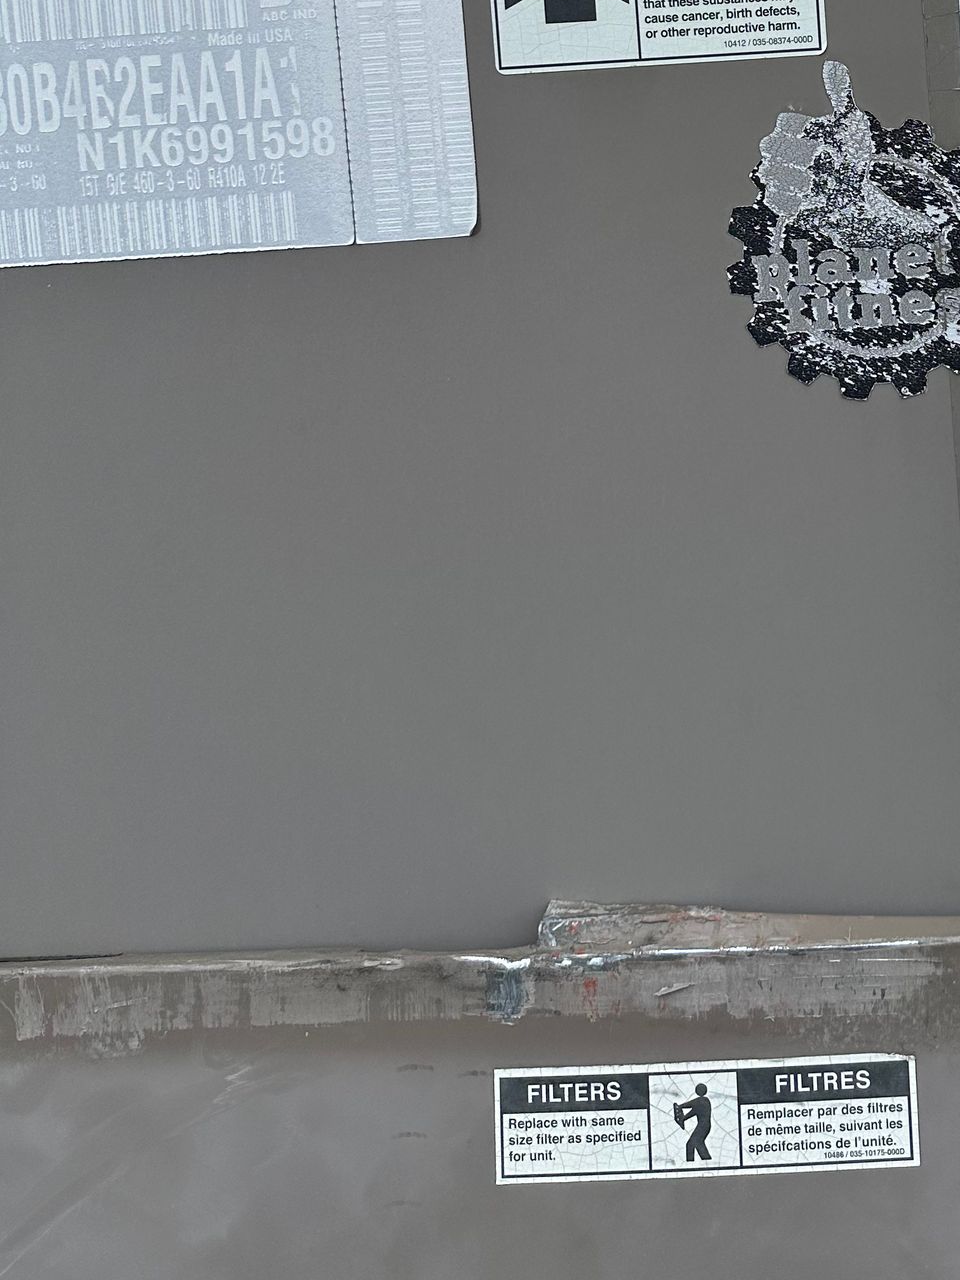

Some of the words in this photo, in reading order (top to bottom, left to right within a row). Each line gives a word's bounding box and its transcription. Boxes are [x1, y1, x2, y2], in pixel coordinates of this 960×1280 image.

[644, 13, 679, 24] cause
[681, 11, 724, 22] cancer,
[725, 7, 753, 19] birth
[754, 5, 800, 18] defects,
[207, 31, 243, 47] Made
[645, 29, 658, 39] or
[660, 26, 691, 38] other
[693, 22, 766, 38] reproductive
[767, 20, 801, 32] harm.
[77, 117, 336, 172] N1K6991598
[751, 227, 956, 303] planet
[775, 1069, 871, 1094] FILTRES
[527, 1081, 621, 1104] FILTERS
[747, 1107, 814, 1121] Remplacer
[817, 1106, 838, 1119] par
[841, 1103, 864, 1115] des
[867, 1102, 903, 1114] filtres
[508, 1117, 558, 1132] Replace
[561, 1116, 587, 1128] with
[591, 1116, 625, 1127] same
[747, 1125, 762, 1137] de
[765, 1123, 801, 1136] même
[804, 1121, 836, 1134] taille,
[839, 1119, 883, 1132] suivant
[885, 1118, 903, 1129] les
[508, 1134, 533, 1146] size
[536, 1133, 564, 1145] filter
[567, 1134, 582, 1144] as
[585, 1129, 642, 1145] specified
[835, 1137, 851, 1149] de
[854, 1134, 897, 1148] l'unité.
[508, 1150, 526, 1162] for
[529, 1150, 556, 1162] unit.
